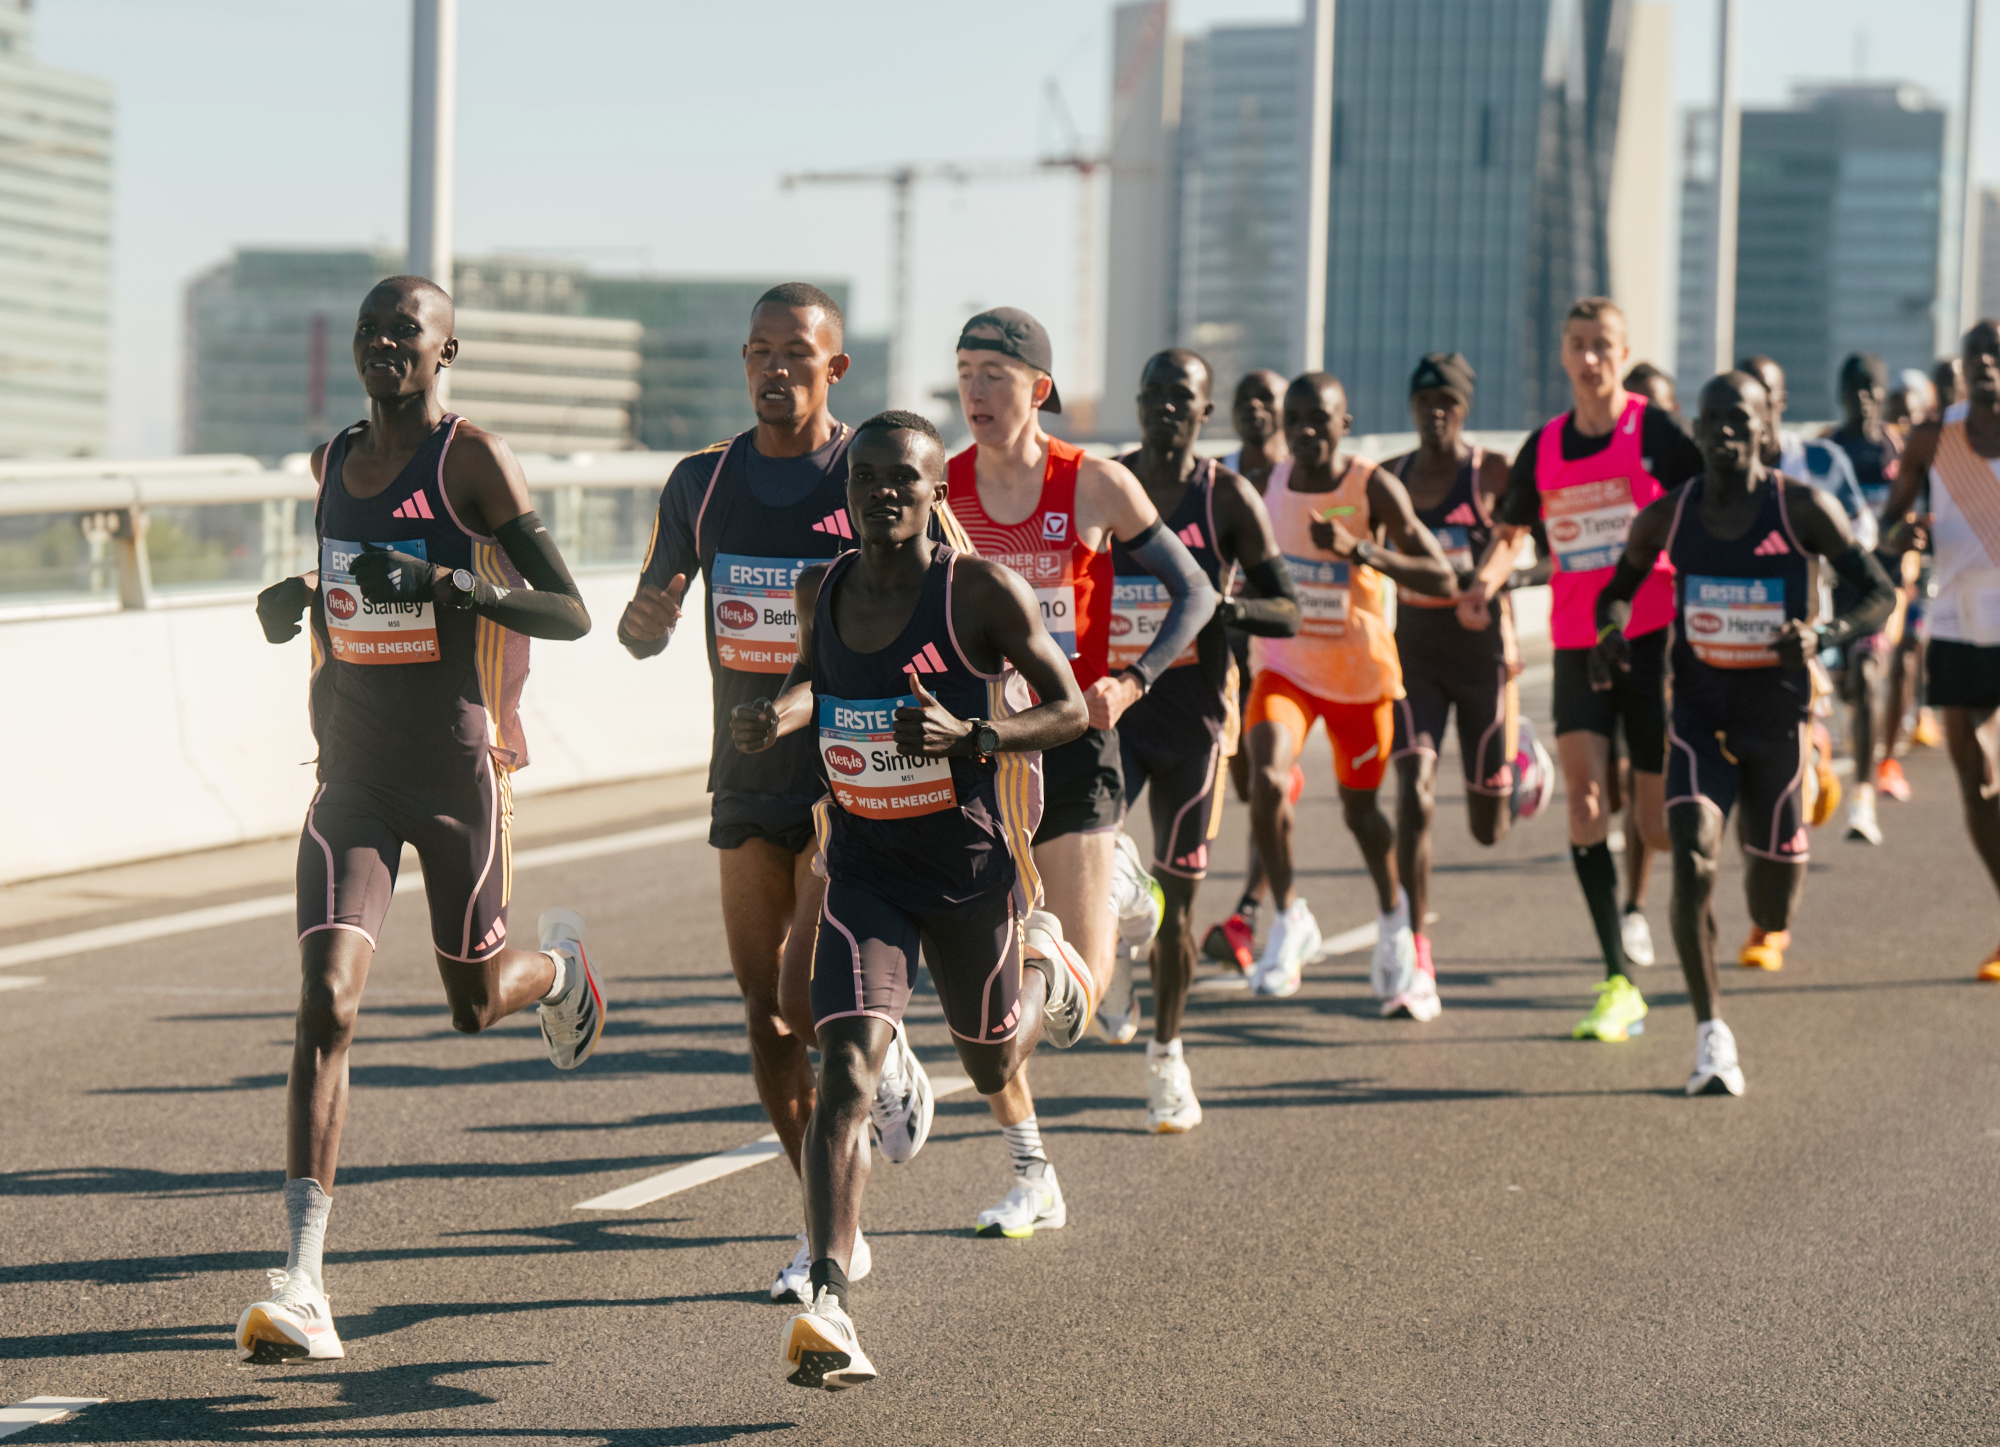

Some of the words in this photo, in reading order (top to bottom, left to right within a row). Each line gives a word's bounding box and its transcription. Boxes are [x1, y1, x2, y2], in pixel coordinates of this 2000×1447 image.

[730, 565, 787, 587] ERSTE
[328, 594, 355, 614] Hervis
[720, 605, 755, 624] Hervis
[346, 641, 375, 654] WIEN
[377, 640, 436, 654] ENERGIE
[739, 650, 772, 663] WIEN
[834, 707, 890, 730] ERSTE
[828, 750, 863, 770] Hervis
[870, 750, 940, 773] Simon
[856, 796, 888, 810] WIEN
[890, 789, 952, 809] ENERGIE
